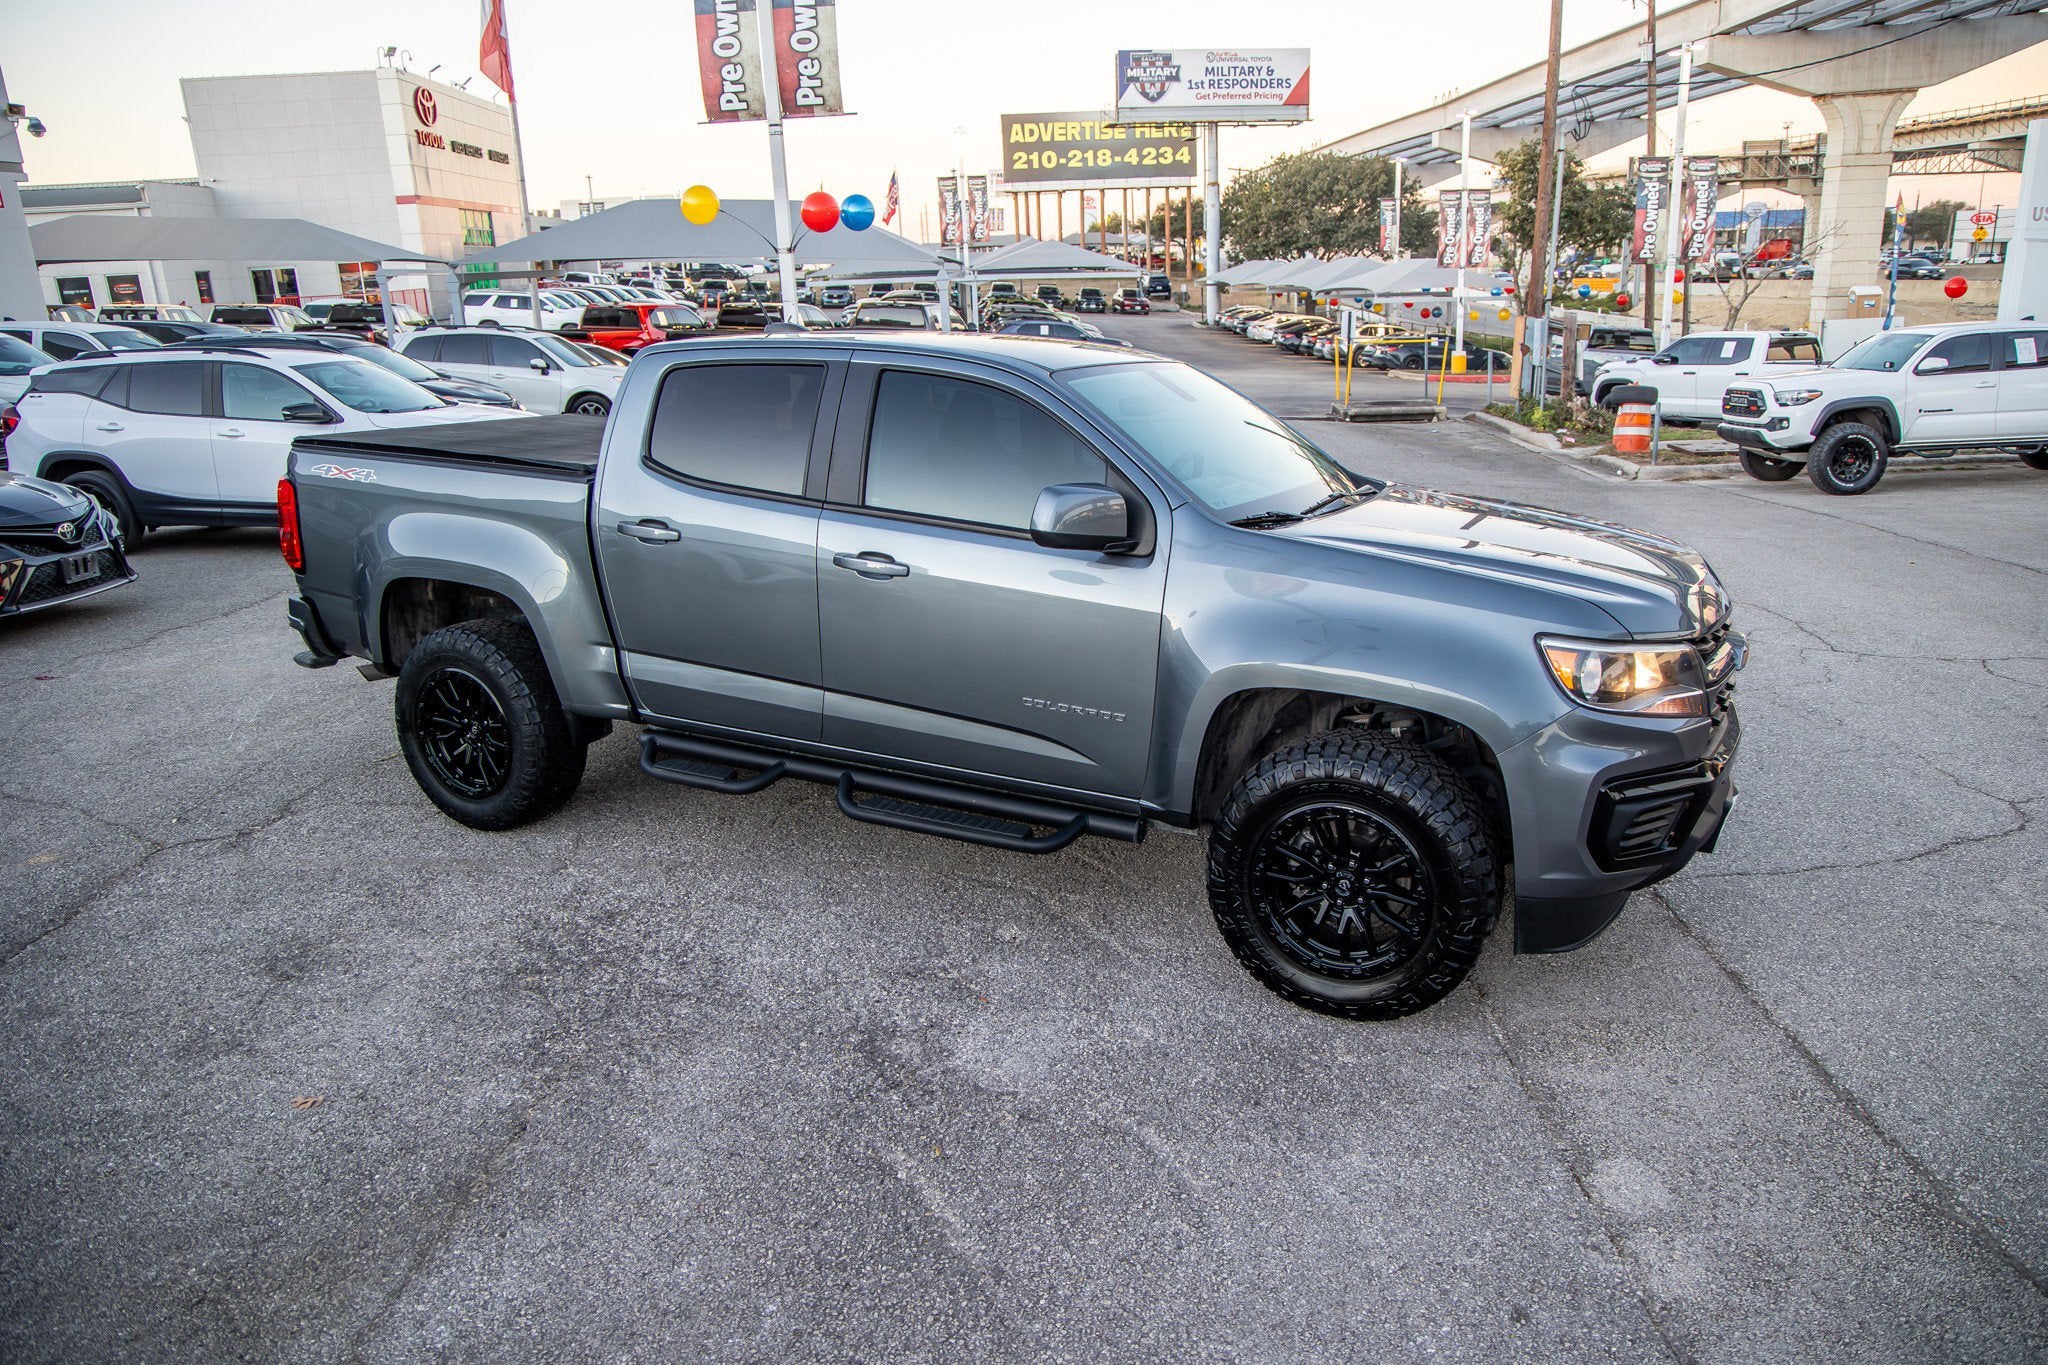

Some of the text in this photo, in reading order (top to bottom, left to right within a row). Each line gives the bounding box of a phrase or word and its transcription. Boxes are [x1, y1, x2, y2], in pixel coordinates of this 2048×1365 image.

[796, 57, 825, 107] Pre
[1127, 66, 1178, 77] MILITARY
[1204, 66, 1275, 77] MILITARY &
[720, 63, 749, 111] Pre
[1187, 78, 1292, 90] 1st RESPONDERS
[1195, 91, 1284, 101] Get Preferred Pricing
[414, 129, 446, 150] TOYOTA
[1009, 120, 1192, 144] ADVERTISE HERE
[1012, 146, 1192, 170] 210-218-4234
[943, 191, 955, 224] Owned
[972, 190, 984, 223] Owned
[1642, 181, 1660, 232] Owned
[1691, 180, 1709, 231] Owned
[1444, 207, 1456, 245] Owned
[1472, 207, 1485, 245] Owned
[1443, 246, 1456, 264] Pre
[1471, 245, 1484, 264] Pre
[1639, 233, 1657, 258] Pre
[1687, 233, 1706, 257] Pre
[1022, 697, 1127, 721] COLORADO
